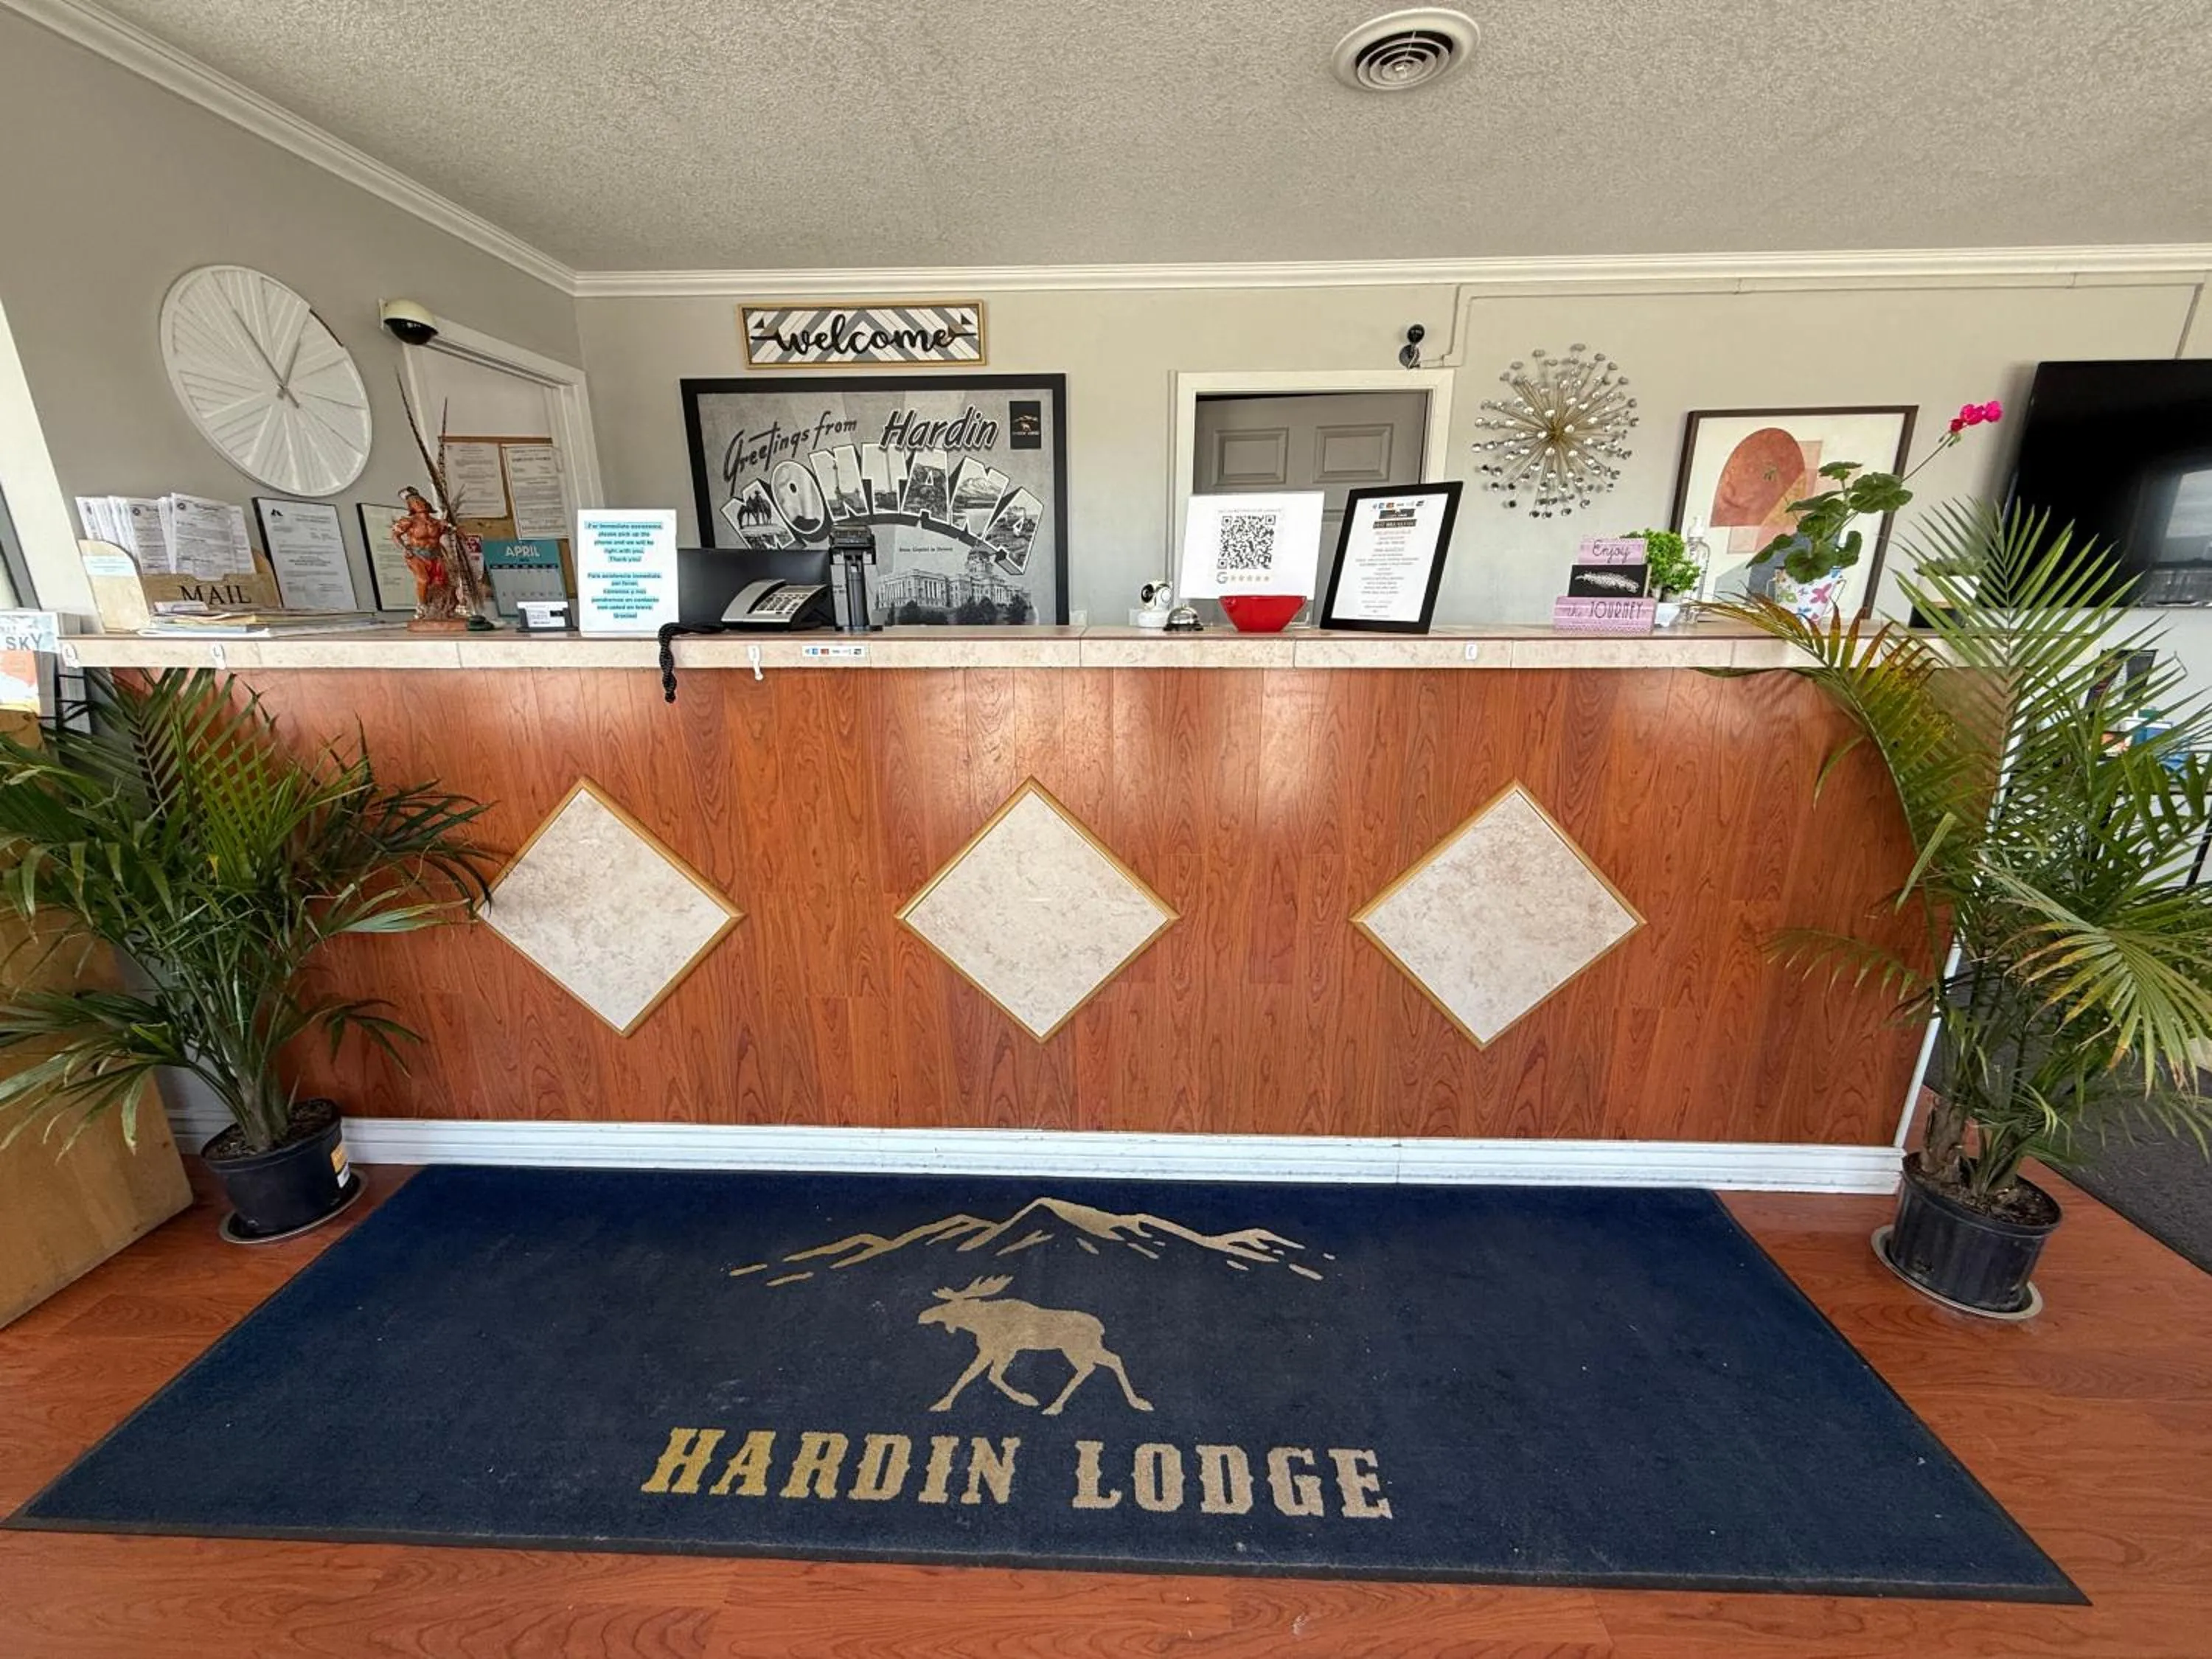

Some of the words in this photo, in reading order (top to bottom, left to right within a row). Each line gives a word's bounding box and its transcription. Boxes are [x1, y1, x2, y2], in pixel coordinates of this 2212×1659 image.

[774, 313, 956, 355] welcome
[879, 406, 1000, 452] Hardin
[723, 421, 810, 496] Greetings
[813, 411, 858, 450] from
[720, 443, 1044, 575] MONTANA
[505, 545, 540, 557] APRIL
[1593, 539, 1630, 563] Enjoy
[178, 585, 251, 605] MAIL
[1590, 601, 1644, 620] JOURNEY
[5, 633, 43, 651] SKY
[641, 1427, 1020, 1504] HARDIN
[1072, 1439, 1392, 1519] LODGE
